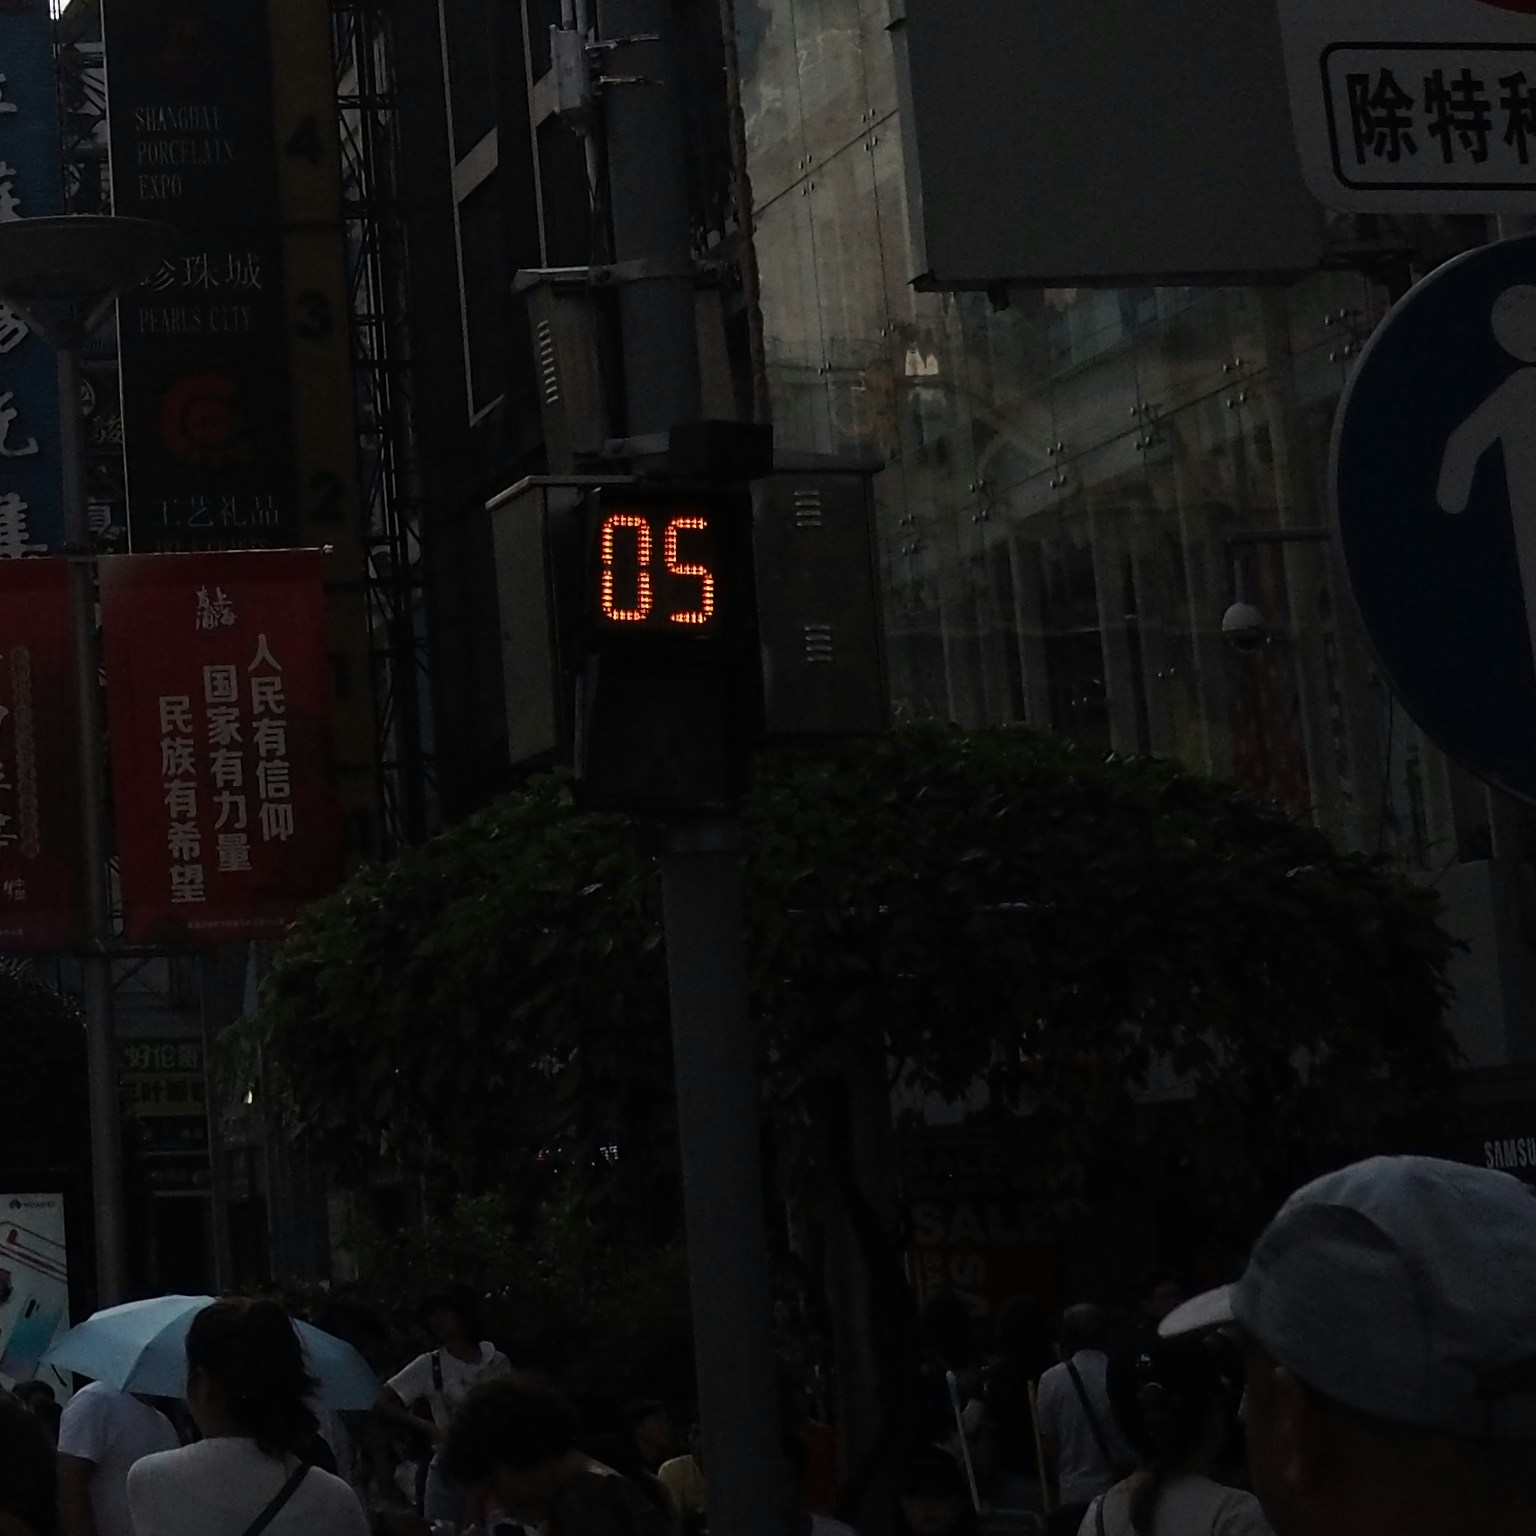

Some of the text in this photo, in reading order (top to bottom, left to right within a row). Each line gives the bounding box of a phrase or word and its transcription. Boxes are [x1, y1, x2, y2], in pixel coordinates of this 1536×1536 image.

[135, 104, 221, 131] SHANGHAI
[137, 138, 236, 166] PORCELAIN
[138, 174, 184, 200] EXPO
[599, 511, 716, 625] 05
[201, 663, 253, 874] 国家有力量
[247, 632, 295, 843] 人民有信仰
[158, 694, 207, 905] 民族有希望
